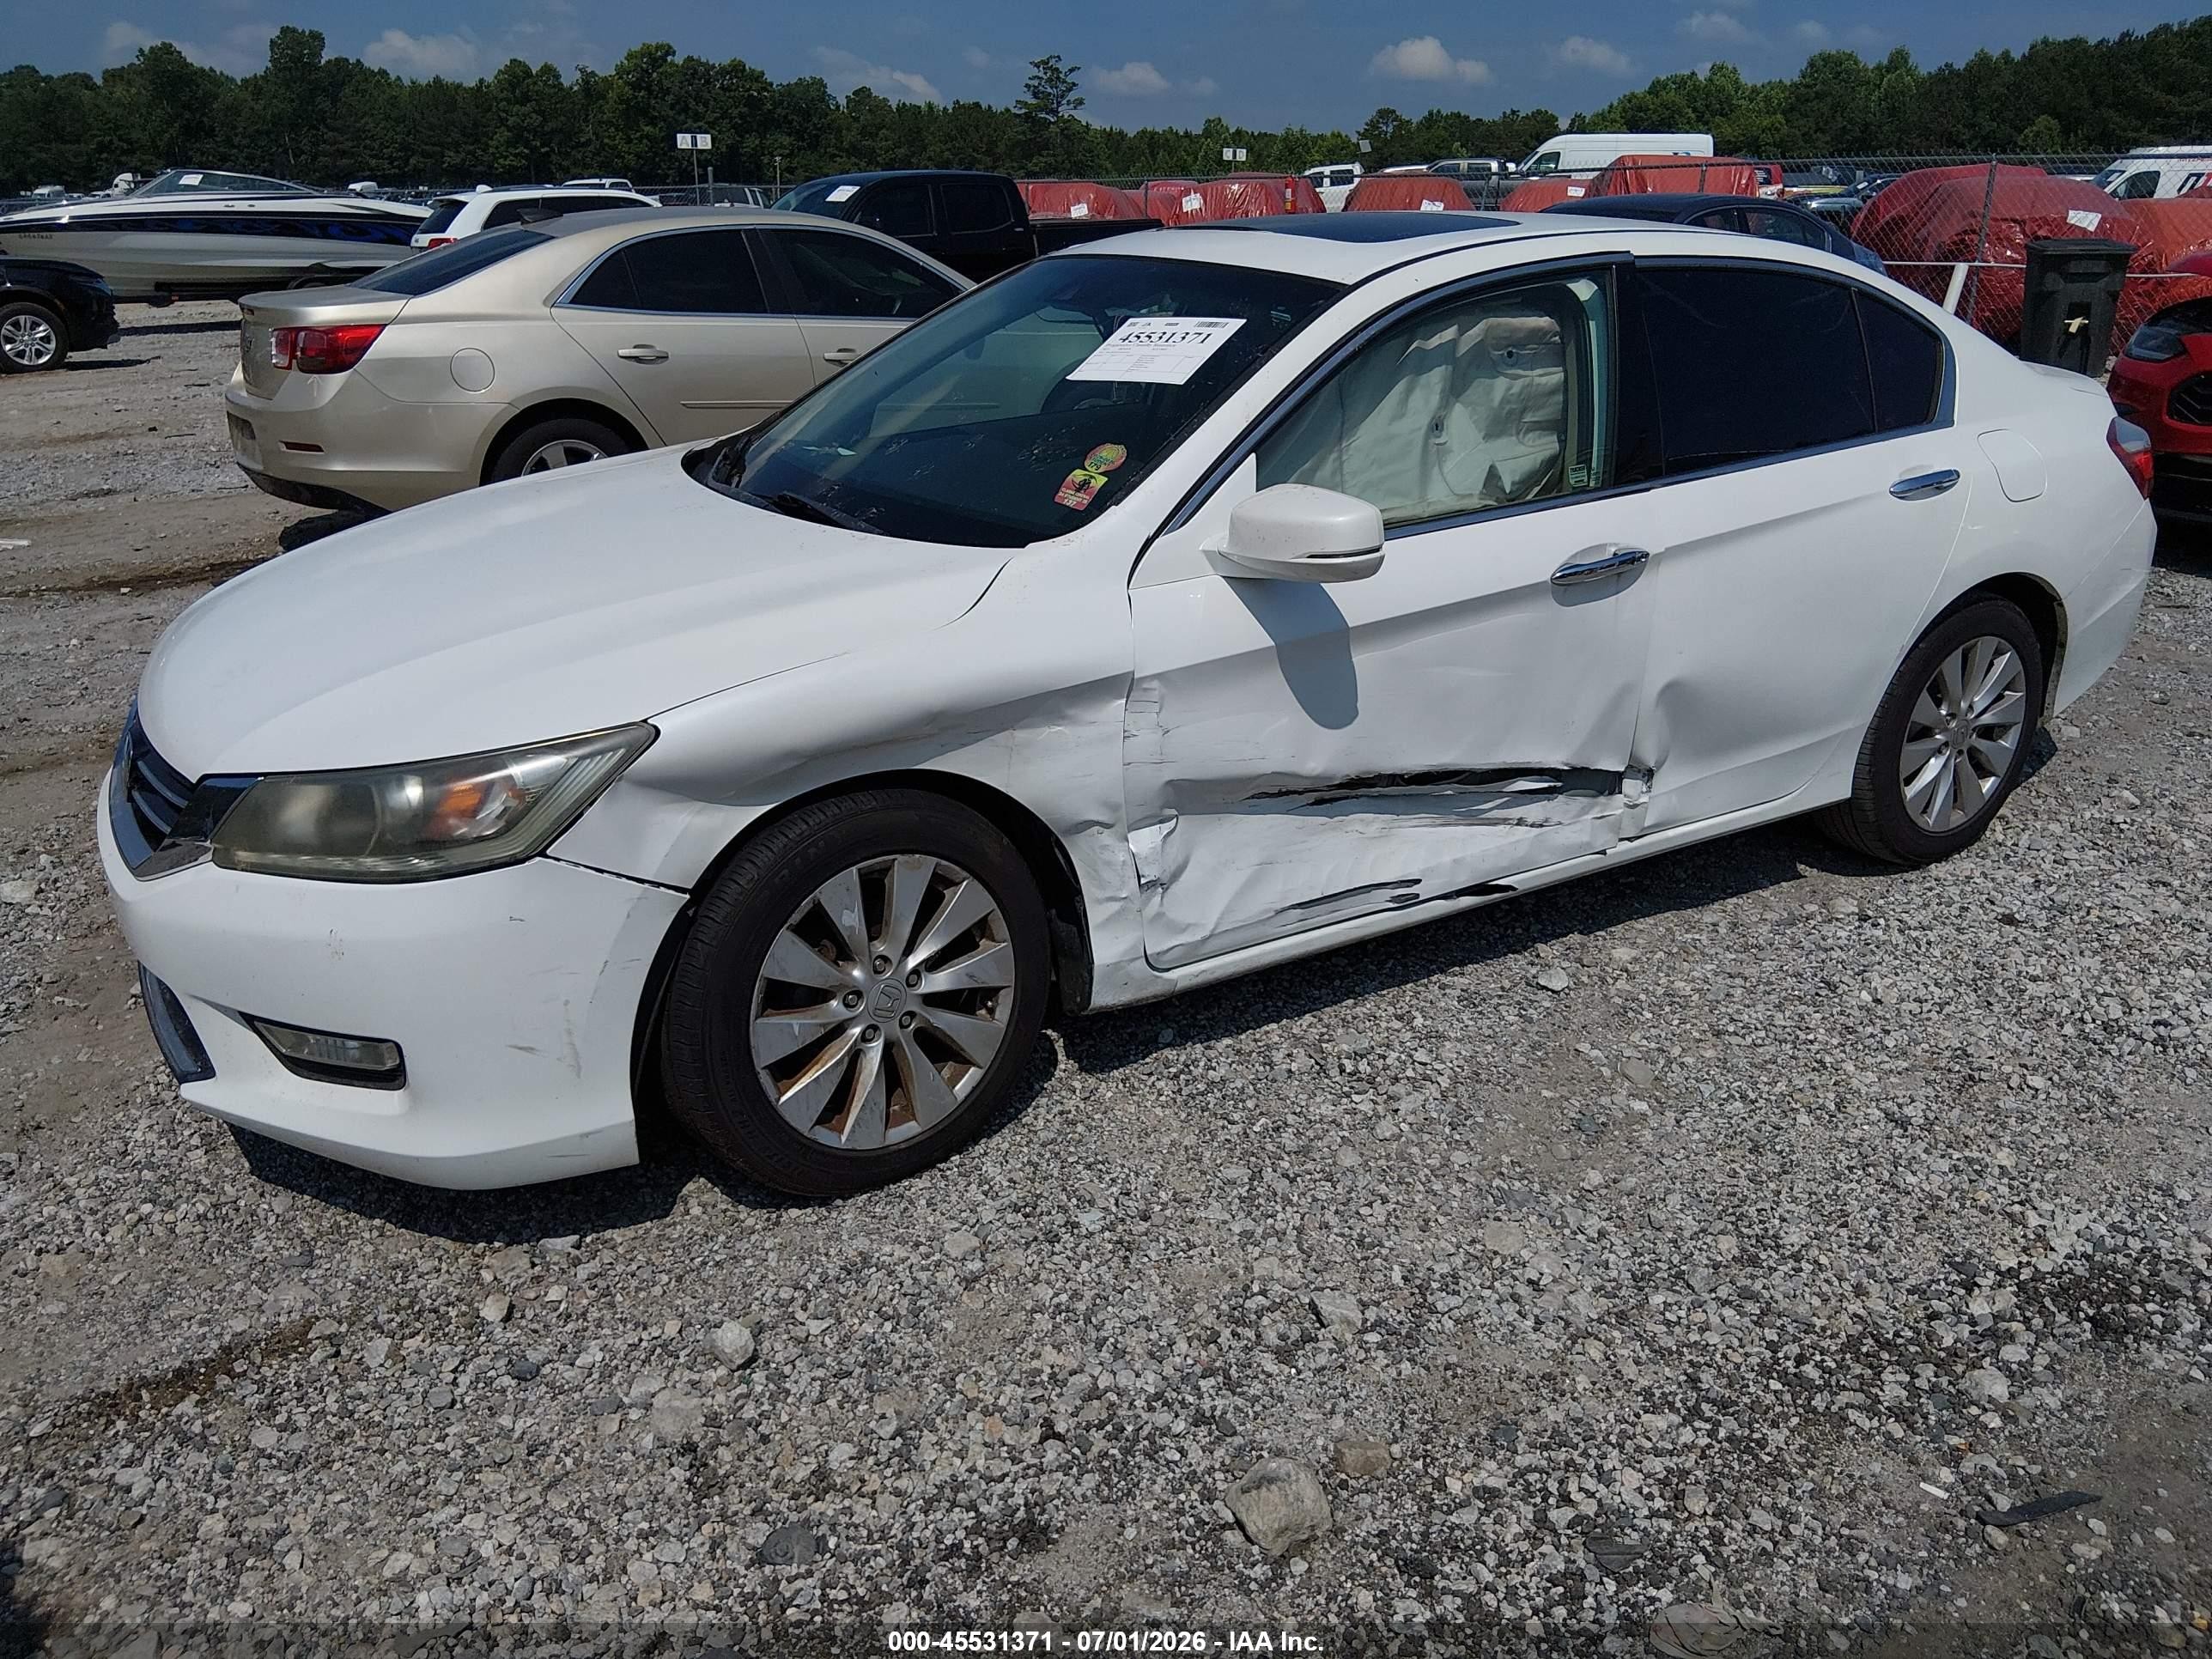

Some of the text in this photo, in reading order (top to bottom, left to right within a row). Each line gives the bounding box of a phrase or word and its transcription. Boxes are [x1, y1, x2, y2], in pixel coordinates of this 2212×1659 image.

[679, 136, 709, 147] A B
[1224, 149, 1244, 159] C D
[1119, 331, 1212, 343] 45531371
